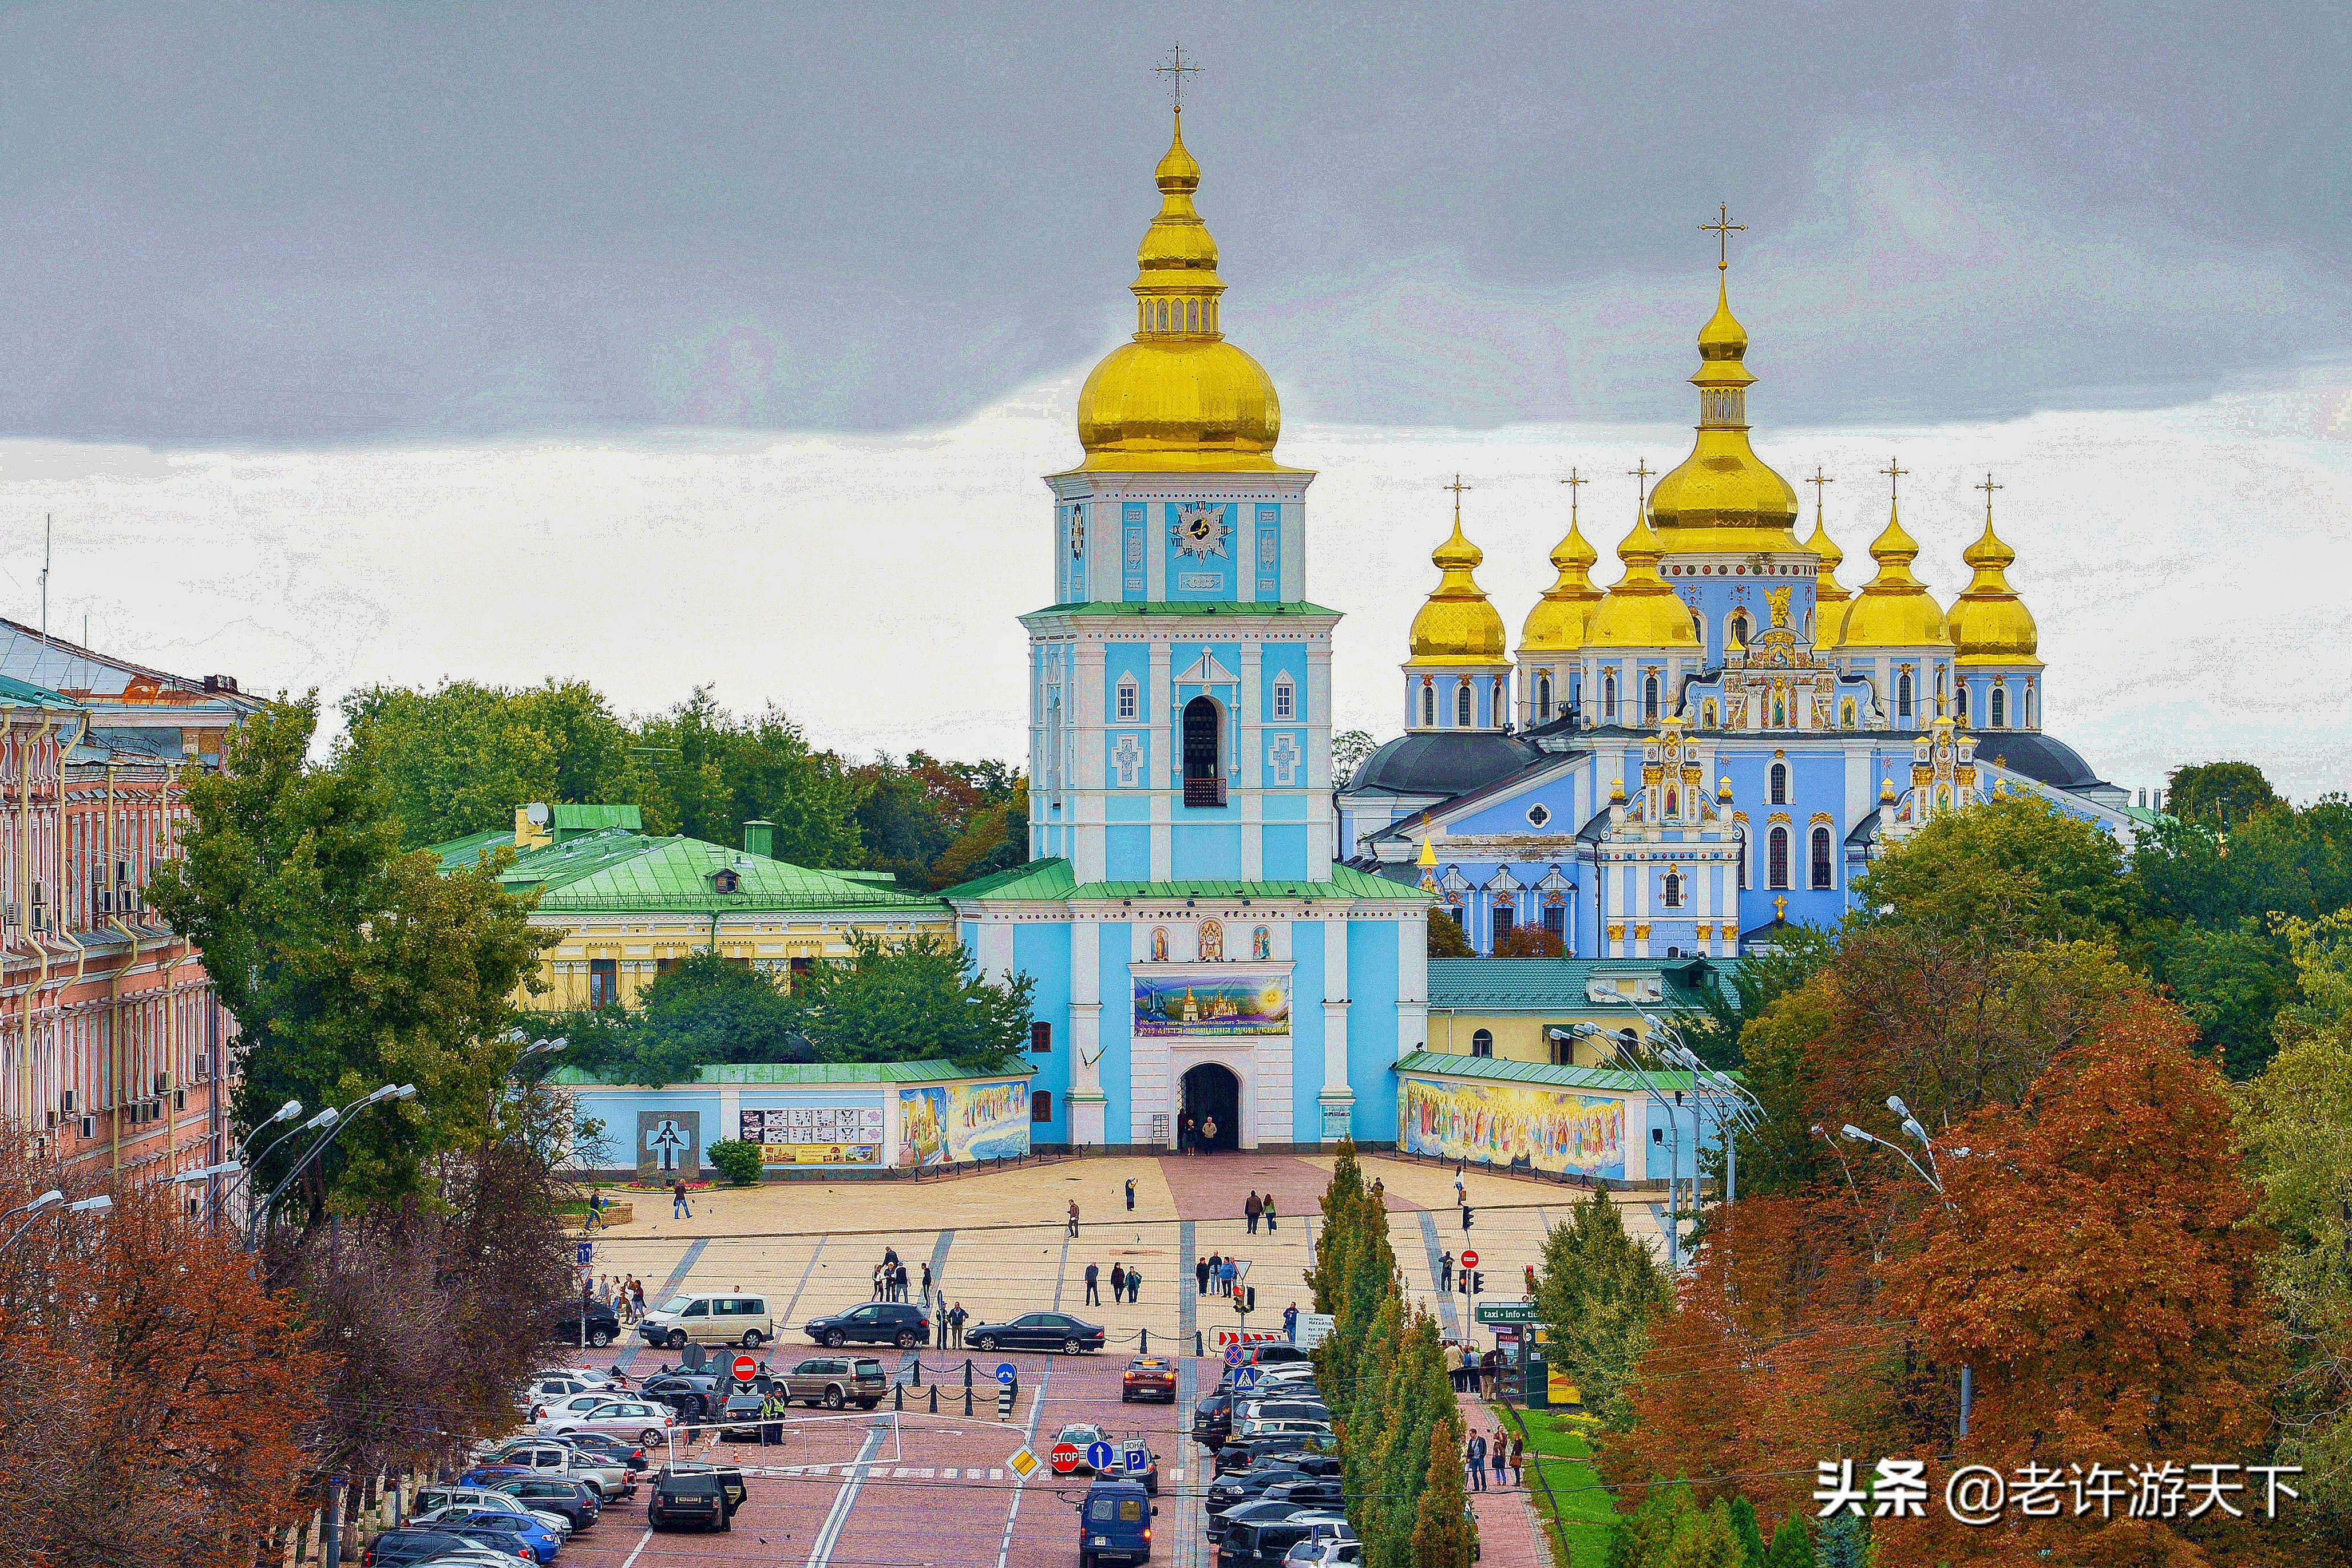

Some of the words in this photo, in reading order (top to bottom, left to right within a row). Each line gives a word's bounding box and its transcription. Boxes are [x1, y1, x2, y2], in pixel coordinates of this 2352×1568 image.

[1196, 501, 1206, 510] XII
[1178, 514, 1182, 523] X
[1218, 514, 1223, 524] II
[1173, 525, 1180, 534] IX
[1171, 537, 1183, 547] VIII
[1218, 538, 1226, 547] IV
[1183, 548, 1192, 556] VII
[1197, 551, 1203, 559] VI
[1210, 548, 1215, 556] V
[1484, 1310, 1499, 1318] taxi
[1505, 1310, 1521, 1318] info
[1052, 1452, 1078, 1463] STOP
[1130, 1452, 1141, 1470] P
